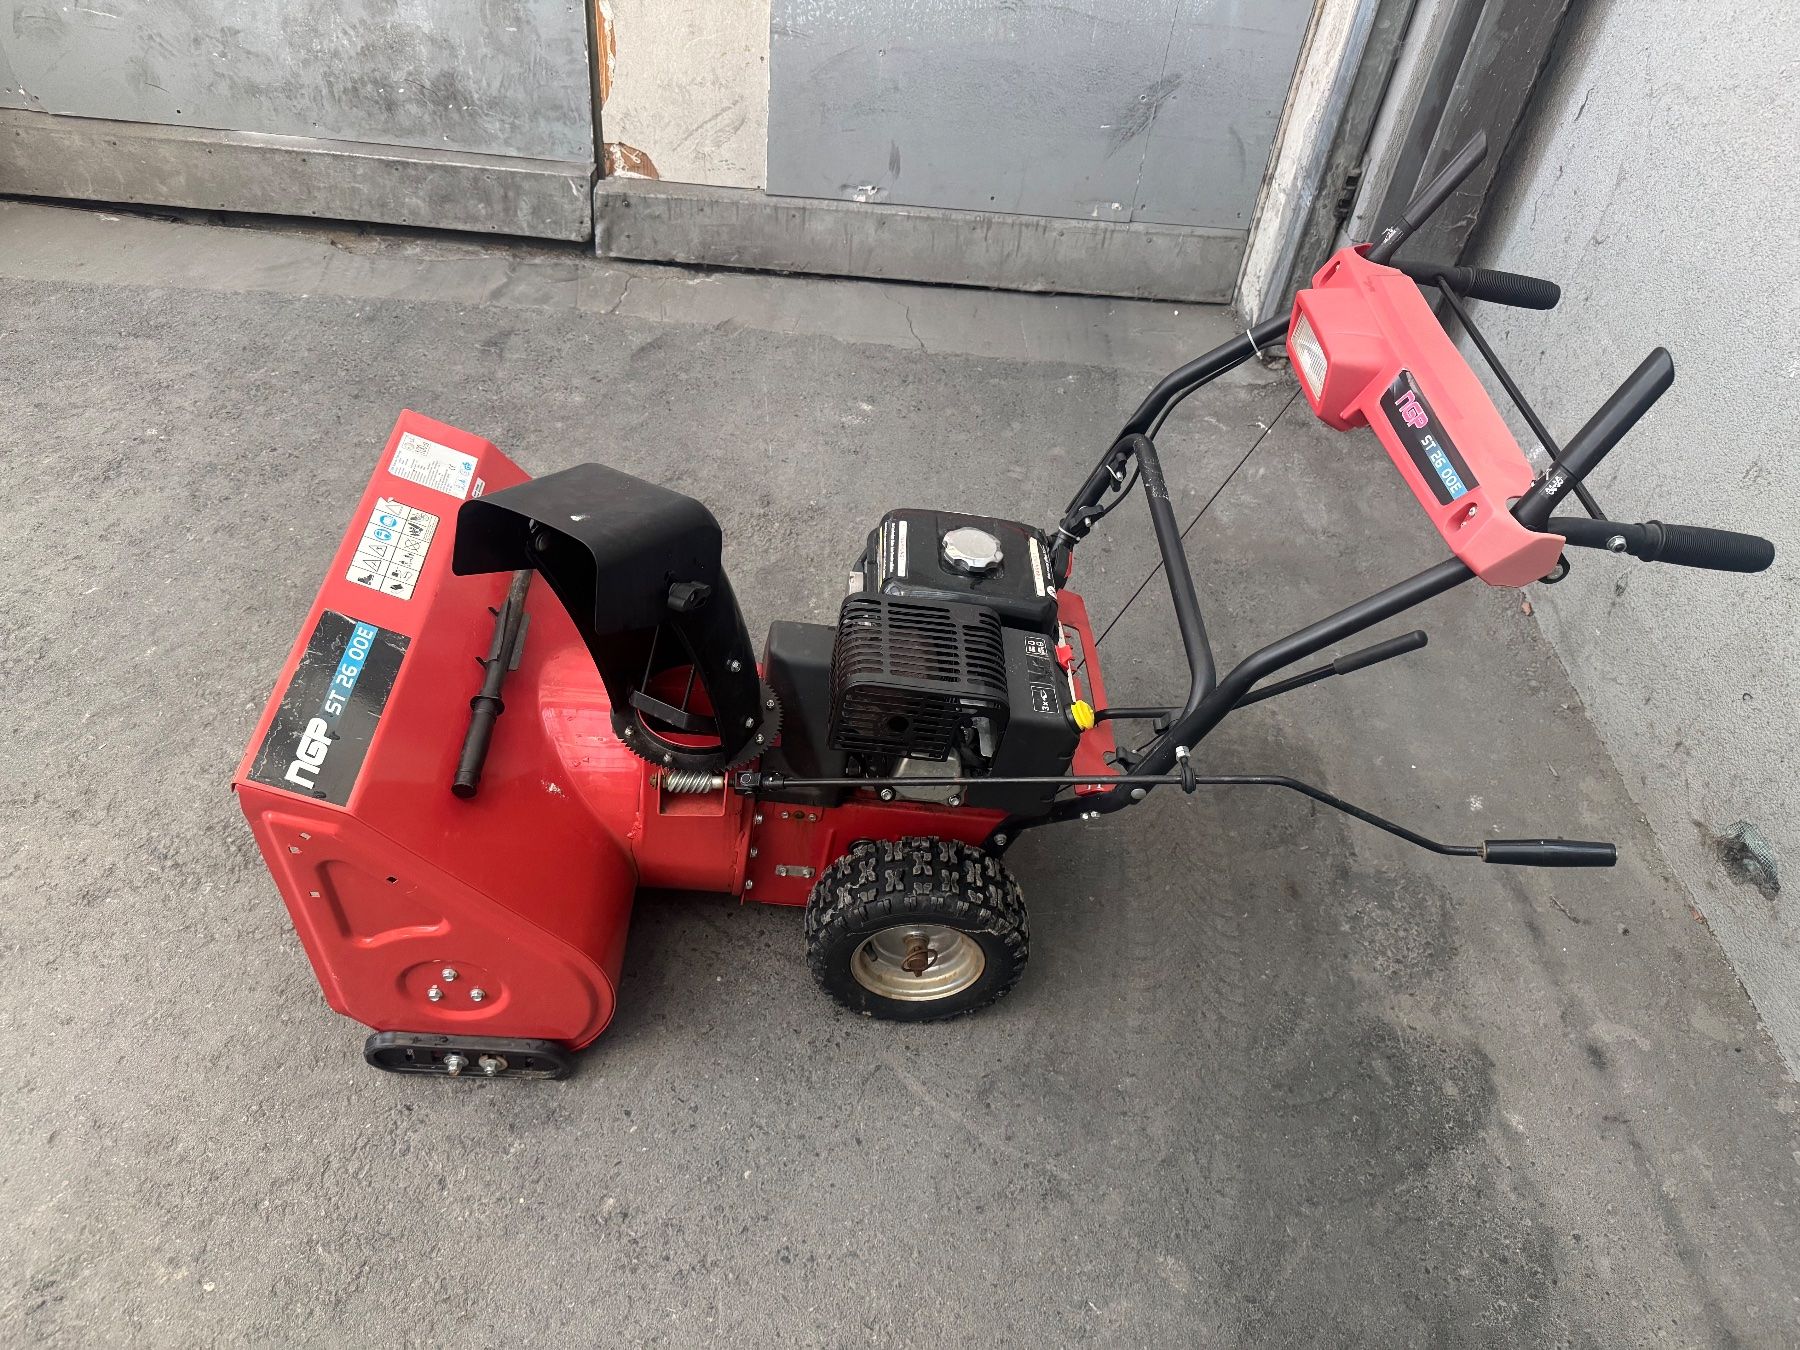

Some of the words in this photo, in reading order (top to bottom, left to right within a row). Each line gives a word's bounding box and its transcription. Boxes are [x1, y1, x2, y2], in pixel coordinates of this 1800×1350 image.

[1421, 434, 1436, 451] ST
[1430, 450, 1446, 469] 26
[324, 690, 347, 716] ST
[336, 663, 358, 688] 26
